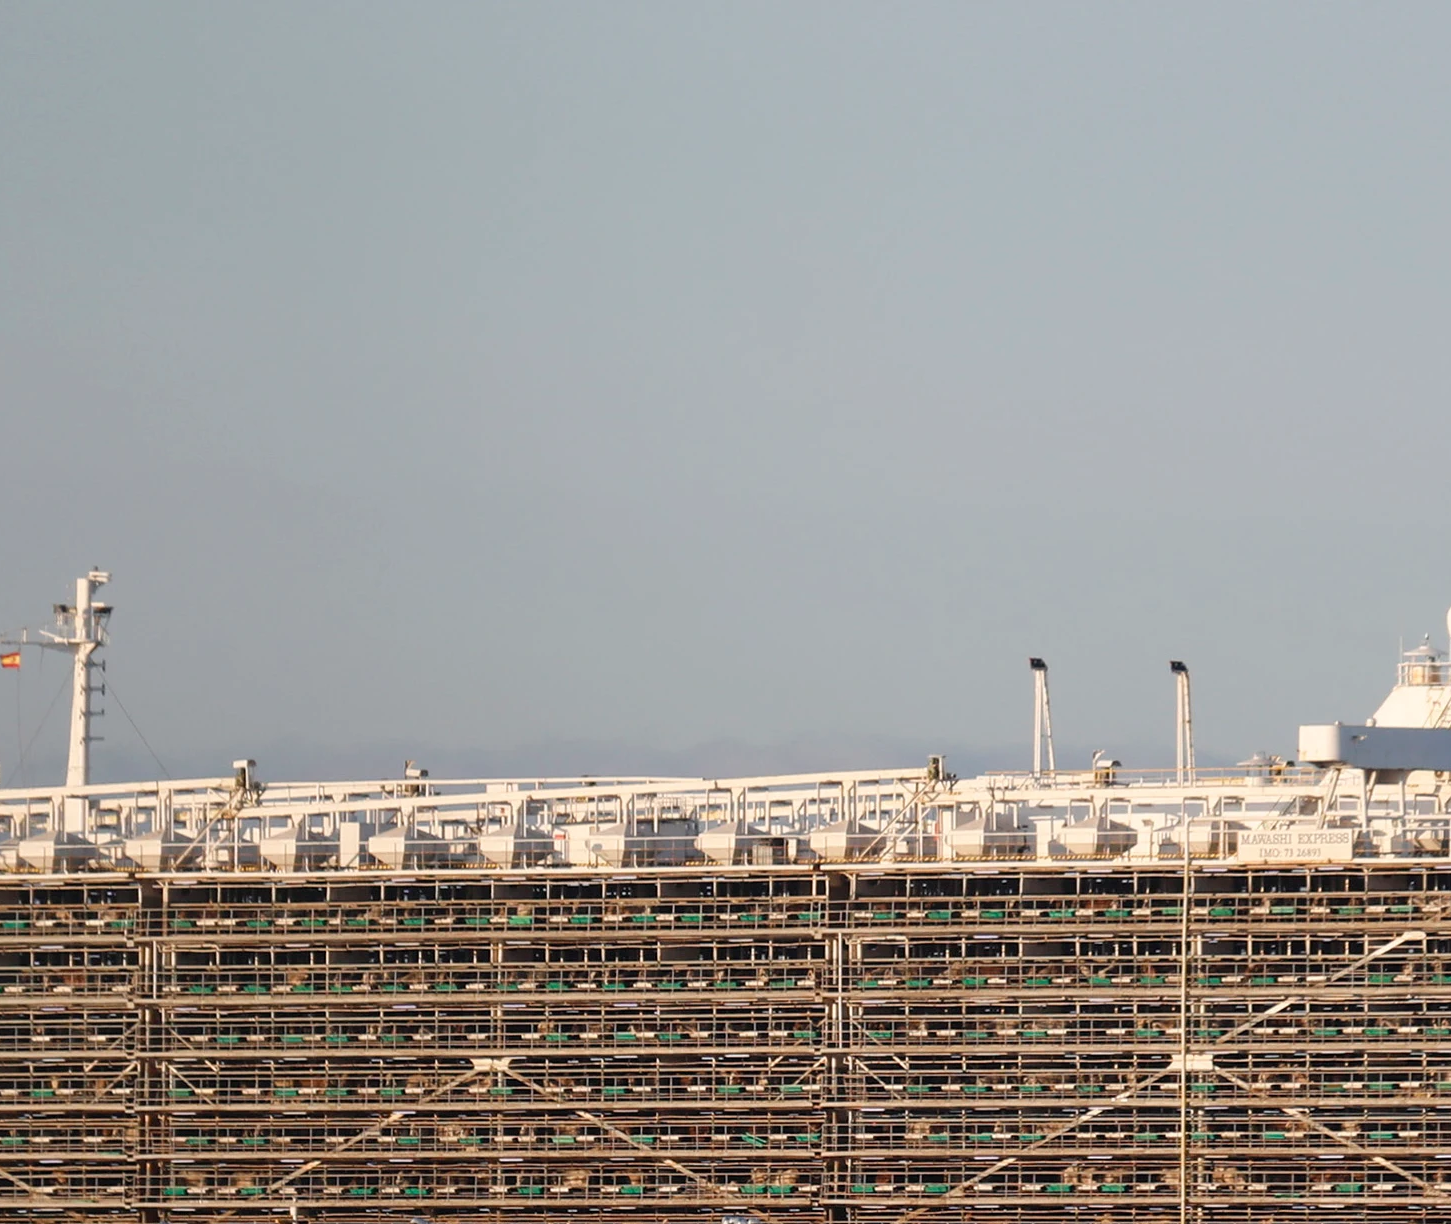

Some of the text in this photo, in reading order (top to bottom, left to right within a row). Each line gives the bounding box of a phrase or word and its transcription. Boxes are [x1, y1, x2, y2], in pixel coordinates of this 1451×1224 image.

[1241, 832, 1349, 845] MAWASHI EXPRESS
[1259, 848, 1281, 857] IMO:
